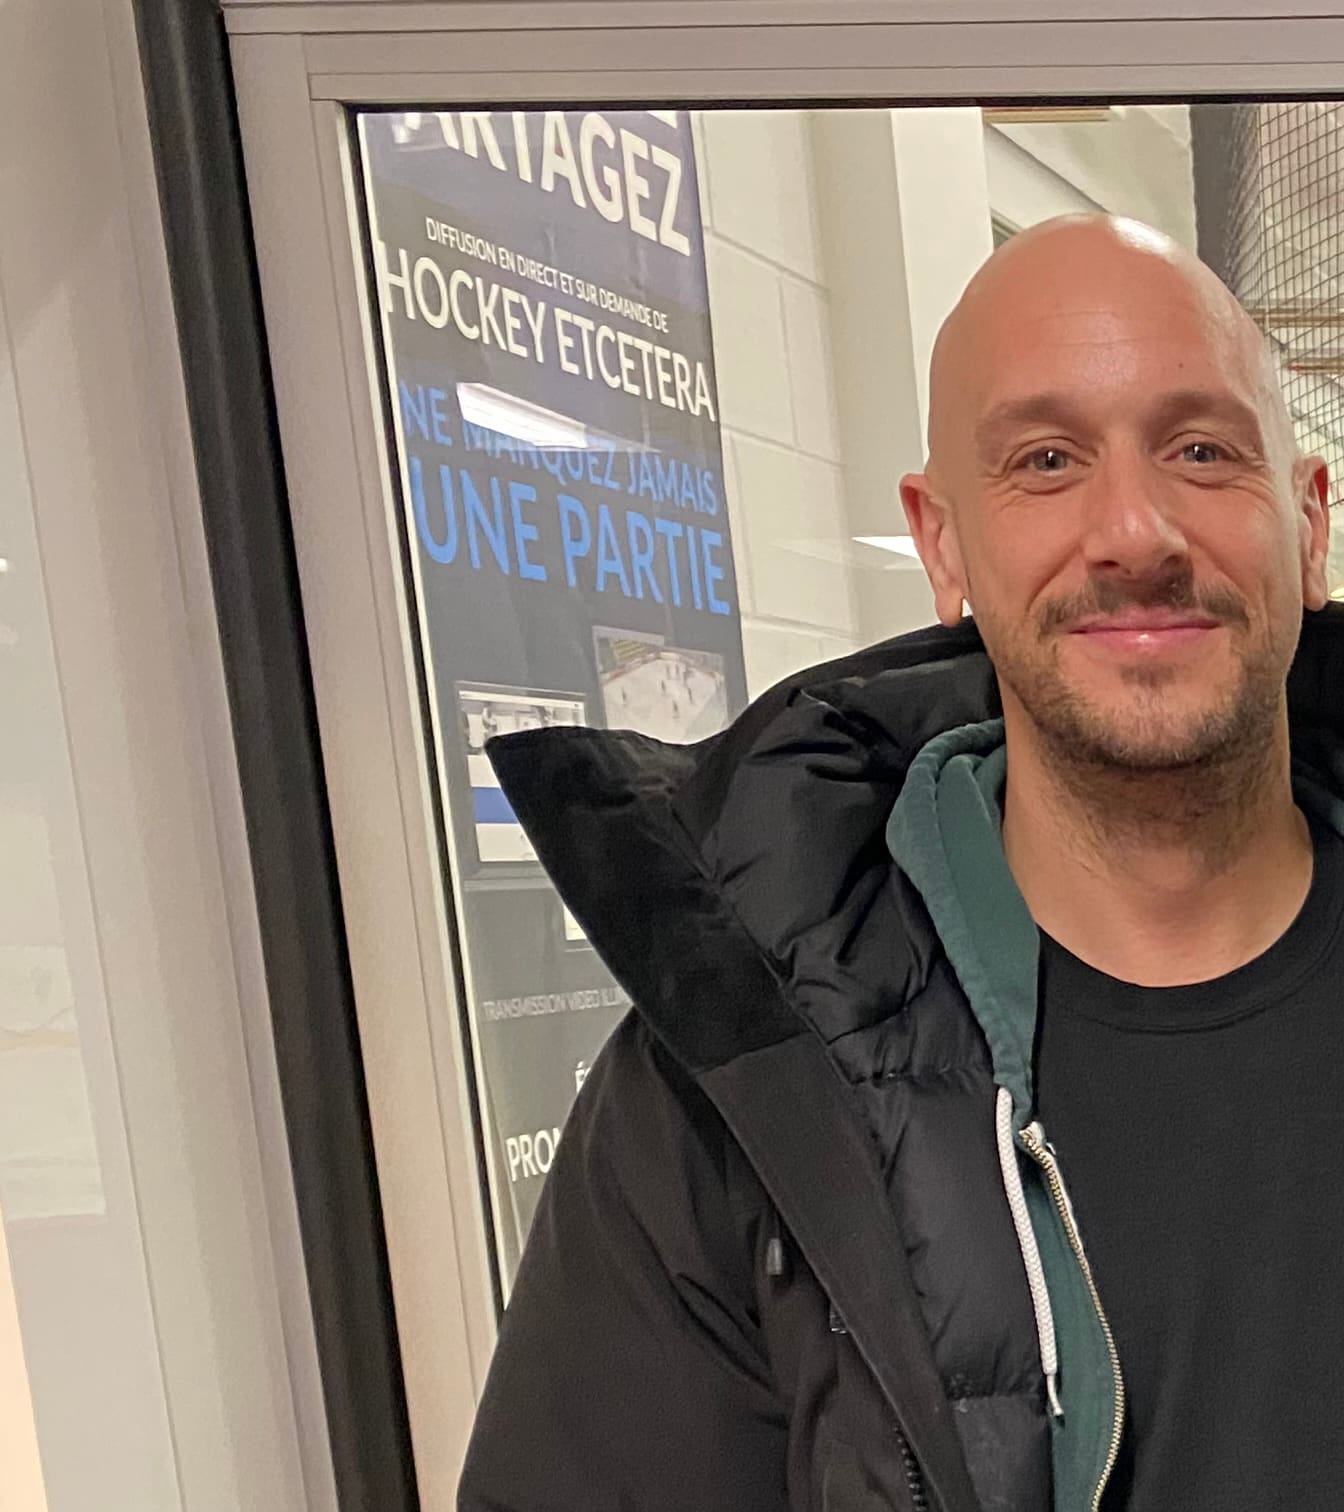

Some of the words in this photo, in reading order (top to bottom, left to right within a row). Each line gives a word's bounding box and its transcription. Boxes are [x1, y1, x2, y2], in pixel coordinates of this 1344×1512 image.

[435, 112, 691, 257] RTAGEZ
[376, 240, 546, 363] HOCKEY
[554, 307, 716, 422] ETCETERA
[425, 216, 497, 266] DIFFUSION
[498, 246, 516, 273] EN
[516, 254, 559, 289] DIRECT
[560, 271, 577, 297] ET
[576, 279, 599, 306] SUR
[599, 288, 653, 328] DEMANDE
[653, 310, 670, 333] DE
[400, 382, 452, 447] NE
[627, 448, 717, 517] JAMAIS
[409, 454, 547, 582] UNE
[557, 493, 730, 615] PARTIE
